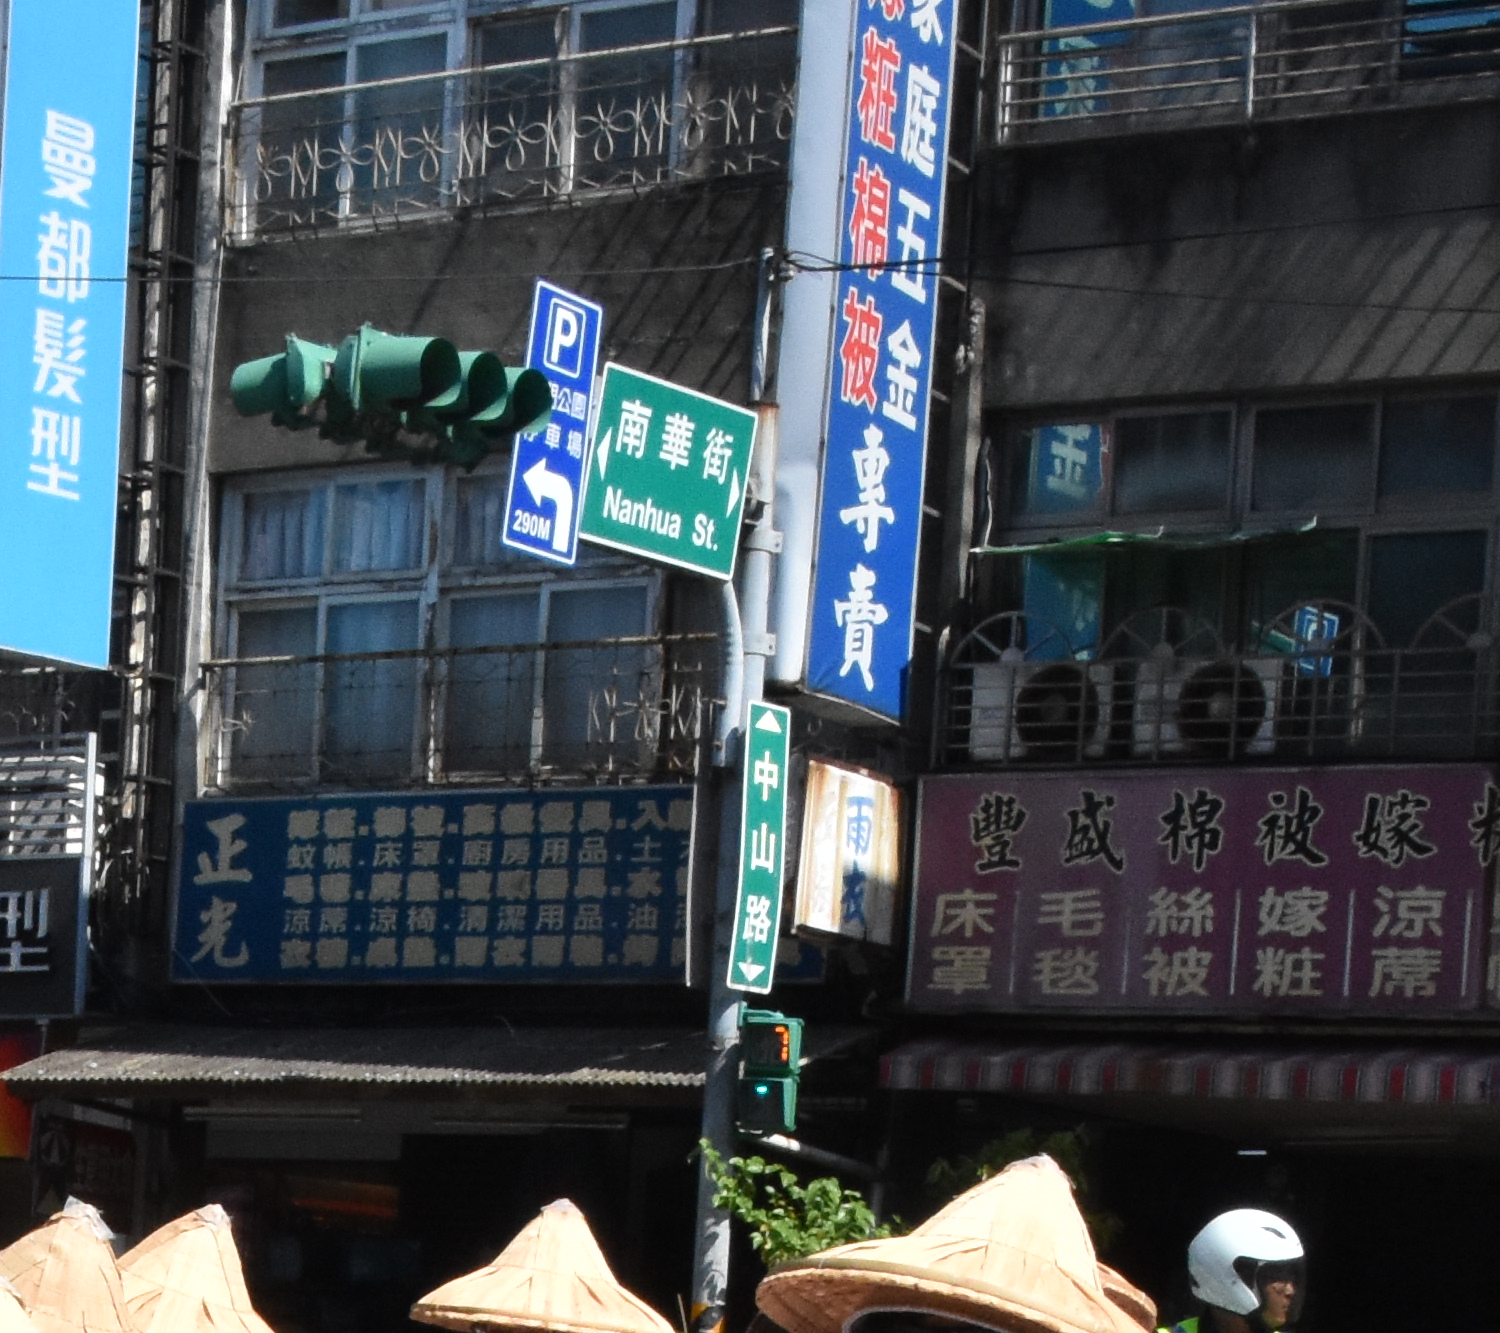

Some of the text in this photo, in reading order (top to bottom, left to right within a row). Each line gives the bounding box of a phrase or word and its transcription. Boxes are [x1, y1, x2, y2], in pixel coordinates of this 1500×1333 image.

[840, 0, 905, 414] 粧棉被
[27, 109, 97, 502] 曼都髮型
[550, 307, 577, 363] P
[616, 400, 734, 485] 南華街
[513, 509, 550, 540] 290M
[603, 486, 719, 551] Nanhua St.
[191, 813, 252, 967] 正光
[743, 751, 778, 943] 中山路
